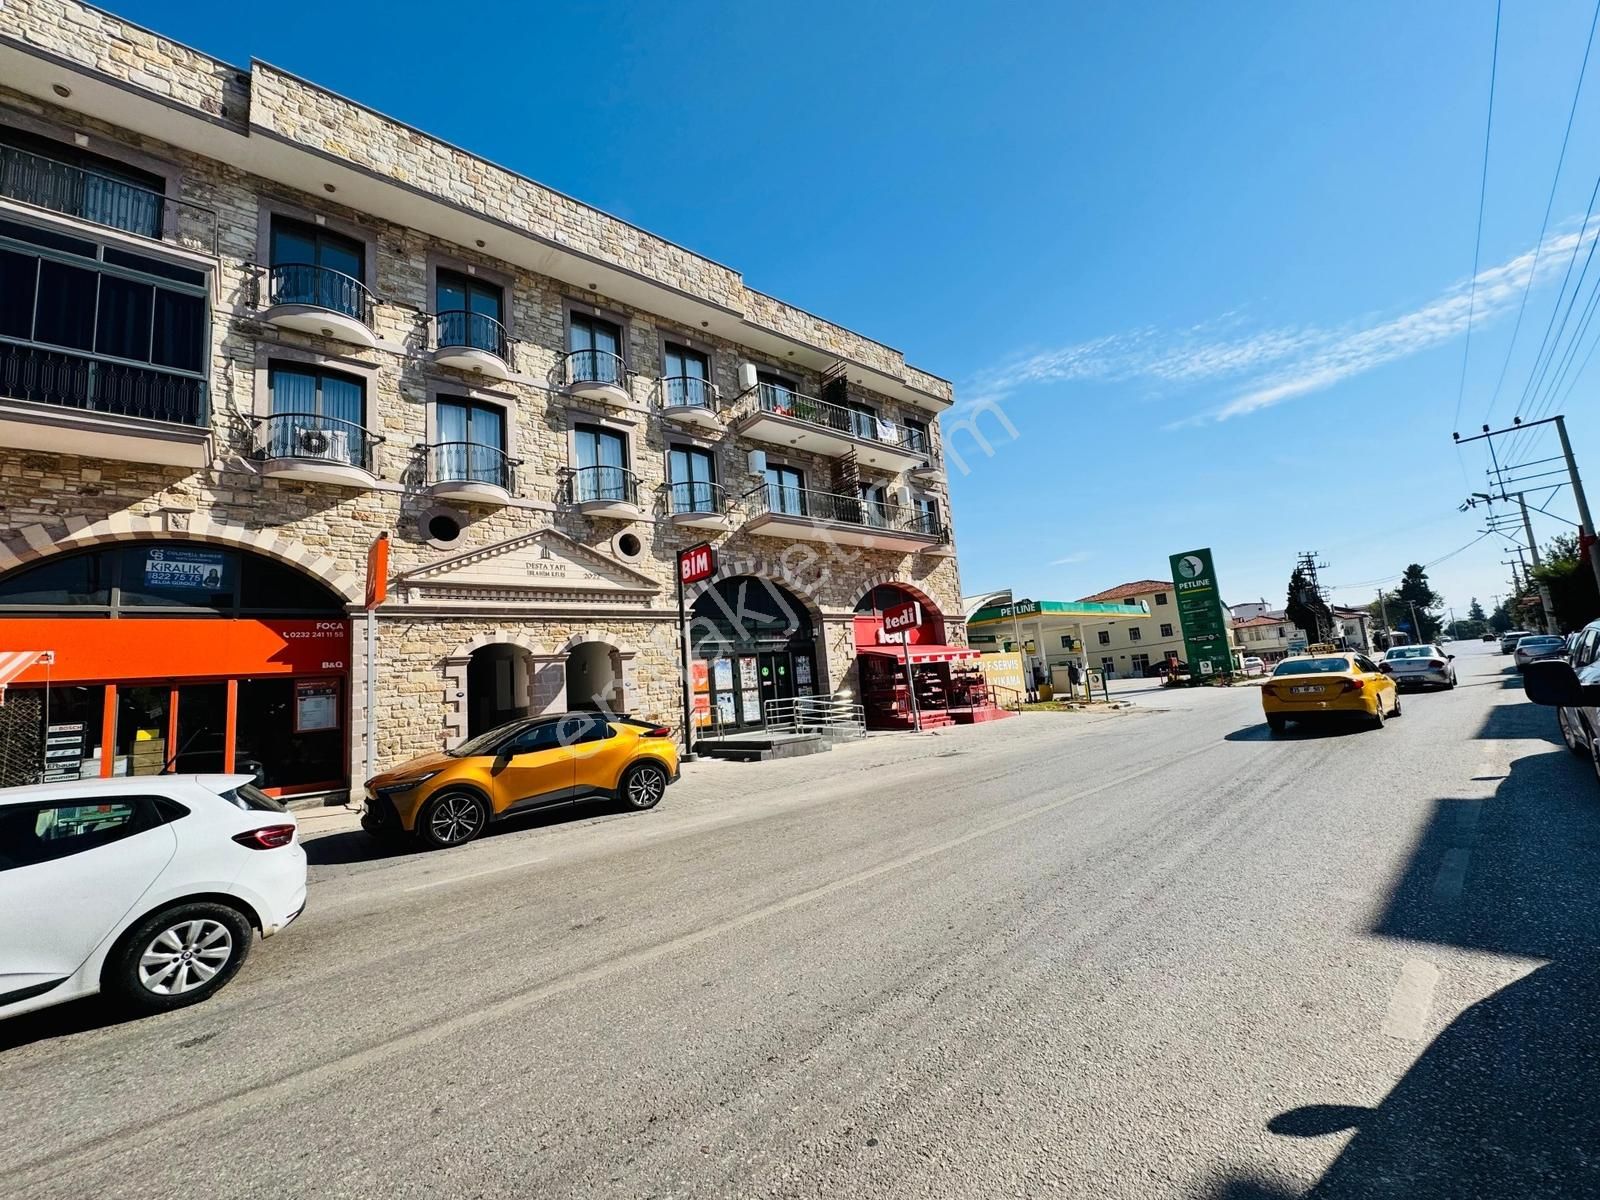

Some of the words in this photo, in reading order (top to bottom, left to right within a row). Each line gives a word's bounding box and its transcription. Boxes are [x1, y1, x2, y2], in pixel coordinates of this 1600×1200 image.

[525, 562, 548, 570] DESTA
[1179, 579, 1211, 590] PETLINE
[1001, 604, 1036, 617] PETLINE
[885, 607, 915, 630] tedi
[316, 622, 344, 631] FOÇA
[321, 661, 343, 669] B&Q
